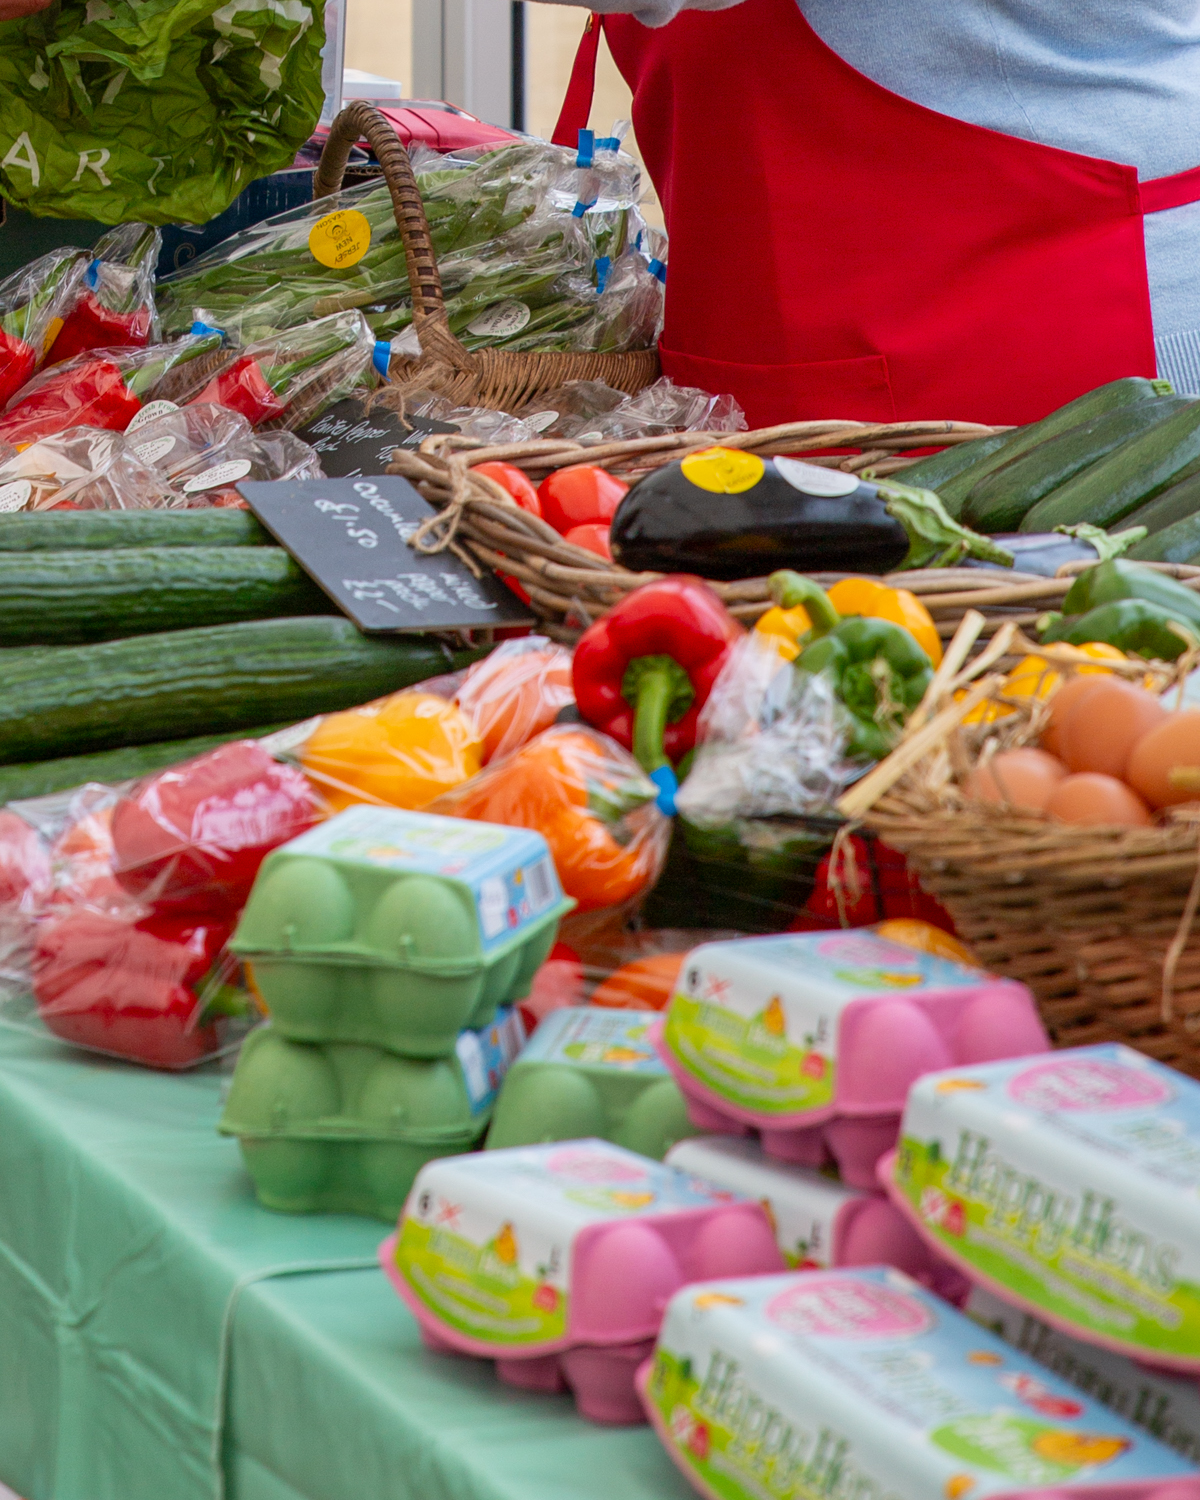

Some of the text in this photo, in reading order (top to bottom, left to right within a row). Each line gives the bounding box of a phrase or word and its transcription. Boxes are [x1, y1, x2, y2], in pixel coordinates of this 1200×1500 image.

[316, 211, 346, 230] SEASON
[334, 242, 360, 265] JERSEY
[335, 236, 353, 251] NEW
[948, 1128, 1072, 1253] Happy
[1070, 1187, 1183, 1288] Hens
